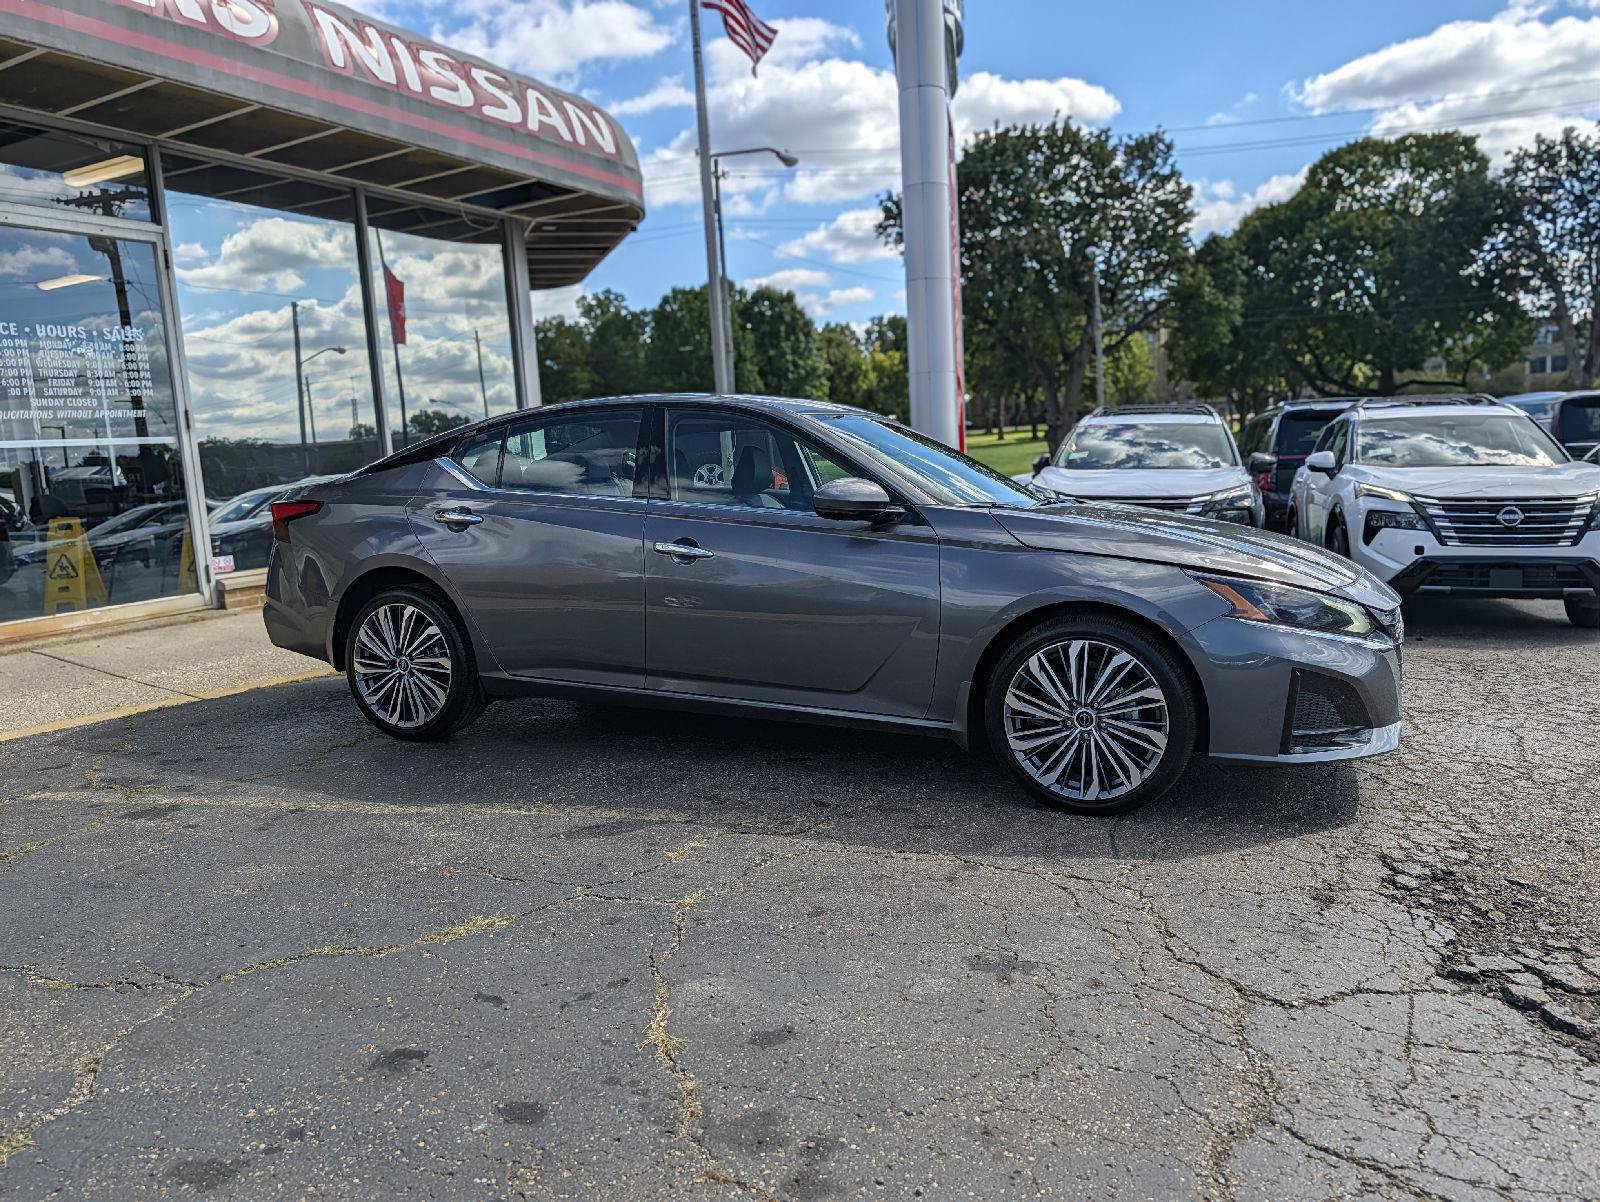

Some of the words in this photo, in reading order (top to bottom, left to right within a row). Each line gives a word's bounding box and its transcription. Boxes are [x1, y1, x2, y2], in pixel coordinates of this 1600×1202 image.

[312, 7, 616, 154] NISSAN
[36, 324, 86, 339] HOURS
[103, 326, 144, 341] SALES
[15, 339, 28, 348] PM
[40, 340, 72, 350] MONDAY
[100, 342, 112, 351] AM
[136, 344, 148, 352] PM
[17, 348, 30, 358] PM
[39, 349, 74, 359] TUESDAY
[138, 353, 149, 362] PM
[18, 358, 31, 367] PM
[36, 359, 80, 368] WEDNESDAY
[103, 361, 115, 369] AM
[139, 362, 150, 371] PM
[20, 369, 33, 377] PM
[38, 369, 78, 378] THURSDAY
[104, 370, 116, 378] AM
[140, 371, 151, 379] PM
[1, 378, 20, 387] 6:00
[22, 378, 35, 387] PM
[48, 378, 76, 387] FRIDAY
[88, 379, 104, 388] 9:00
[105, 379, 117, 388] AM
[124, 380, 140, 388] 6:00
[141, 380, 153, 389] PM
[23, 387, 36, 396] PM
[43, 387, 82, 396] SATURDAY
[89, 388, 106, 396] 9:00
[107, 388, 119, 396] AM
[142, 388, 154, 397] PM
[31, 397, 64, 407] SUNDAY
[66, 397, 98, 407] CLOSED
[56, 409, 94, 418] WITHOUT
[94, 409, 147, 418] APPOINTMENT
